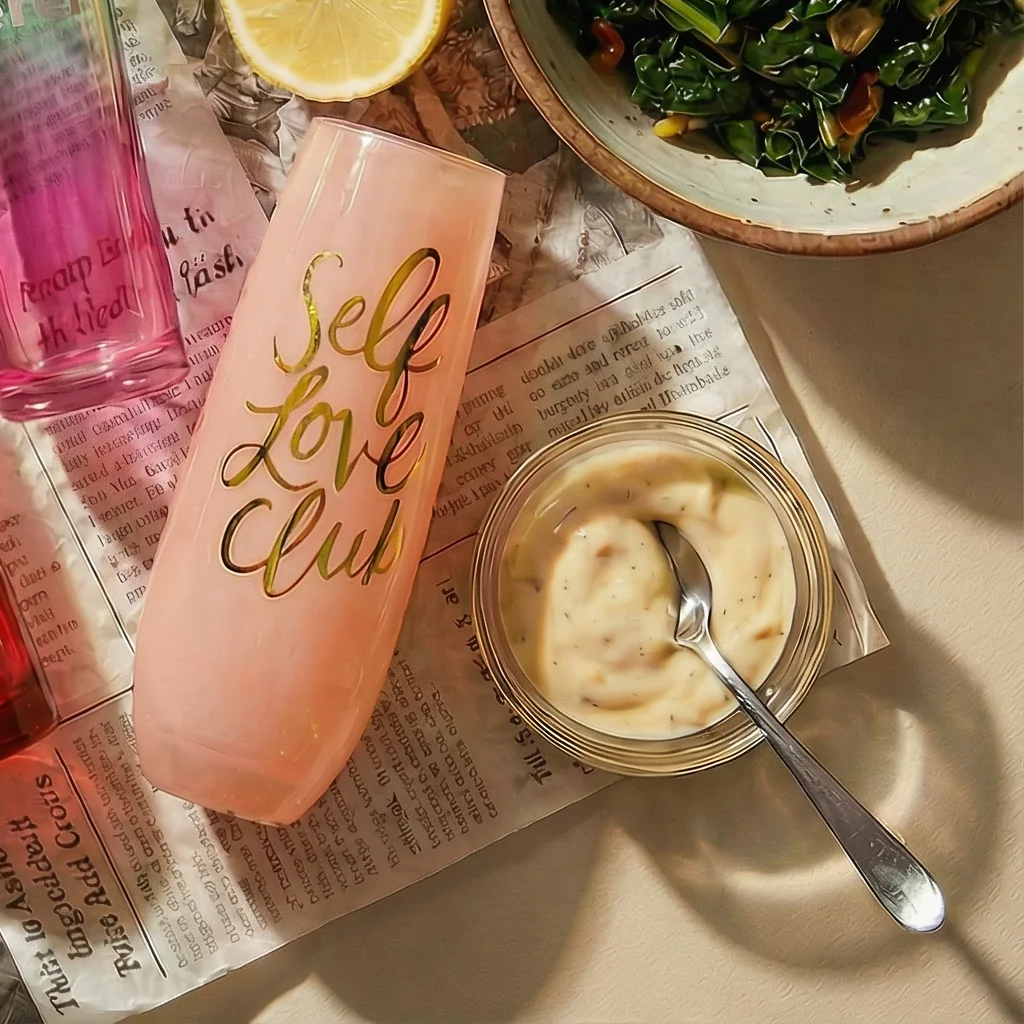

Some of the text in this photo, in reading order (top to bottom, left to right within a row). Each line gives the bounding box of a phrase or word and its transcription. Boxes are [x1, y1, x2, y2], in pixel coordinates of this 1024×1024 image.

[273, 246, 451, 428] Self
[220, 365, 427, 495] Love
[220, 487, 406, 598] Club
